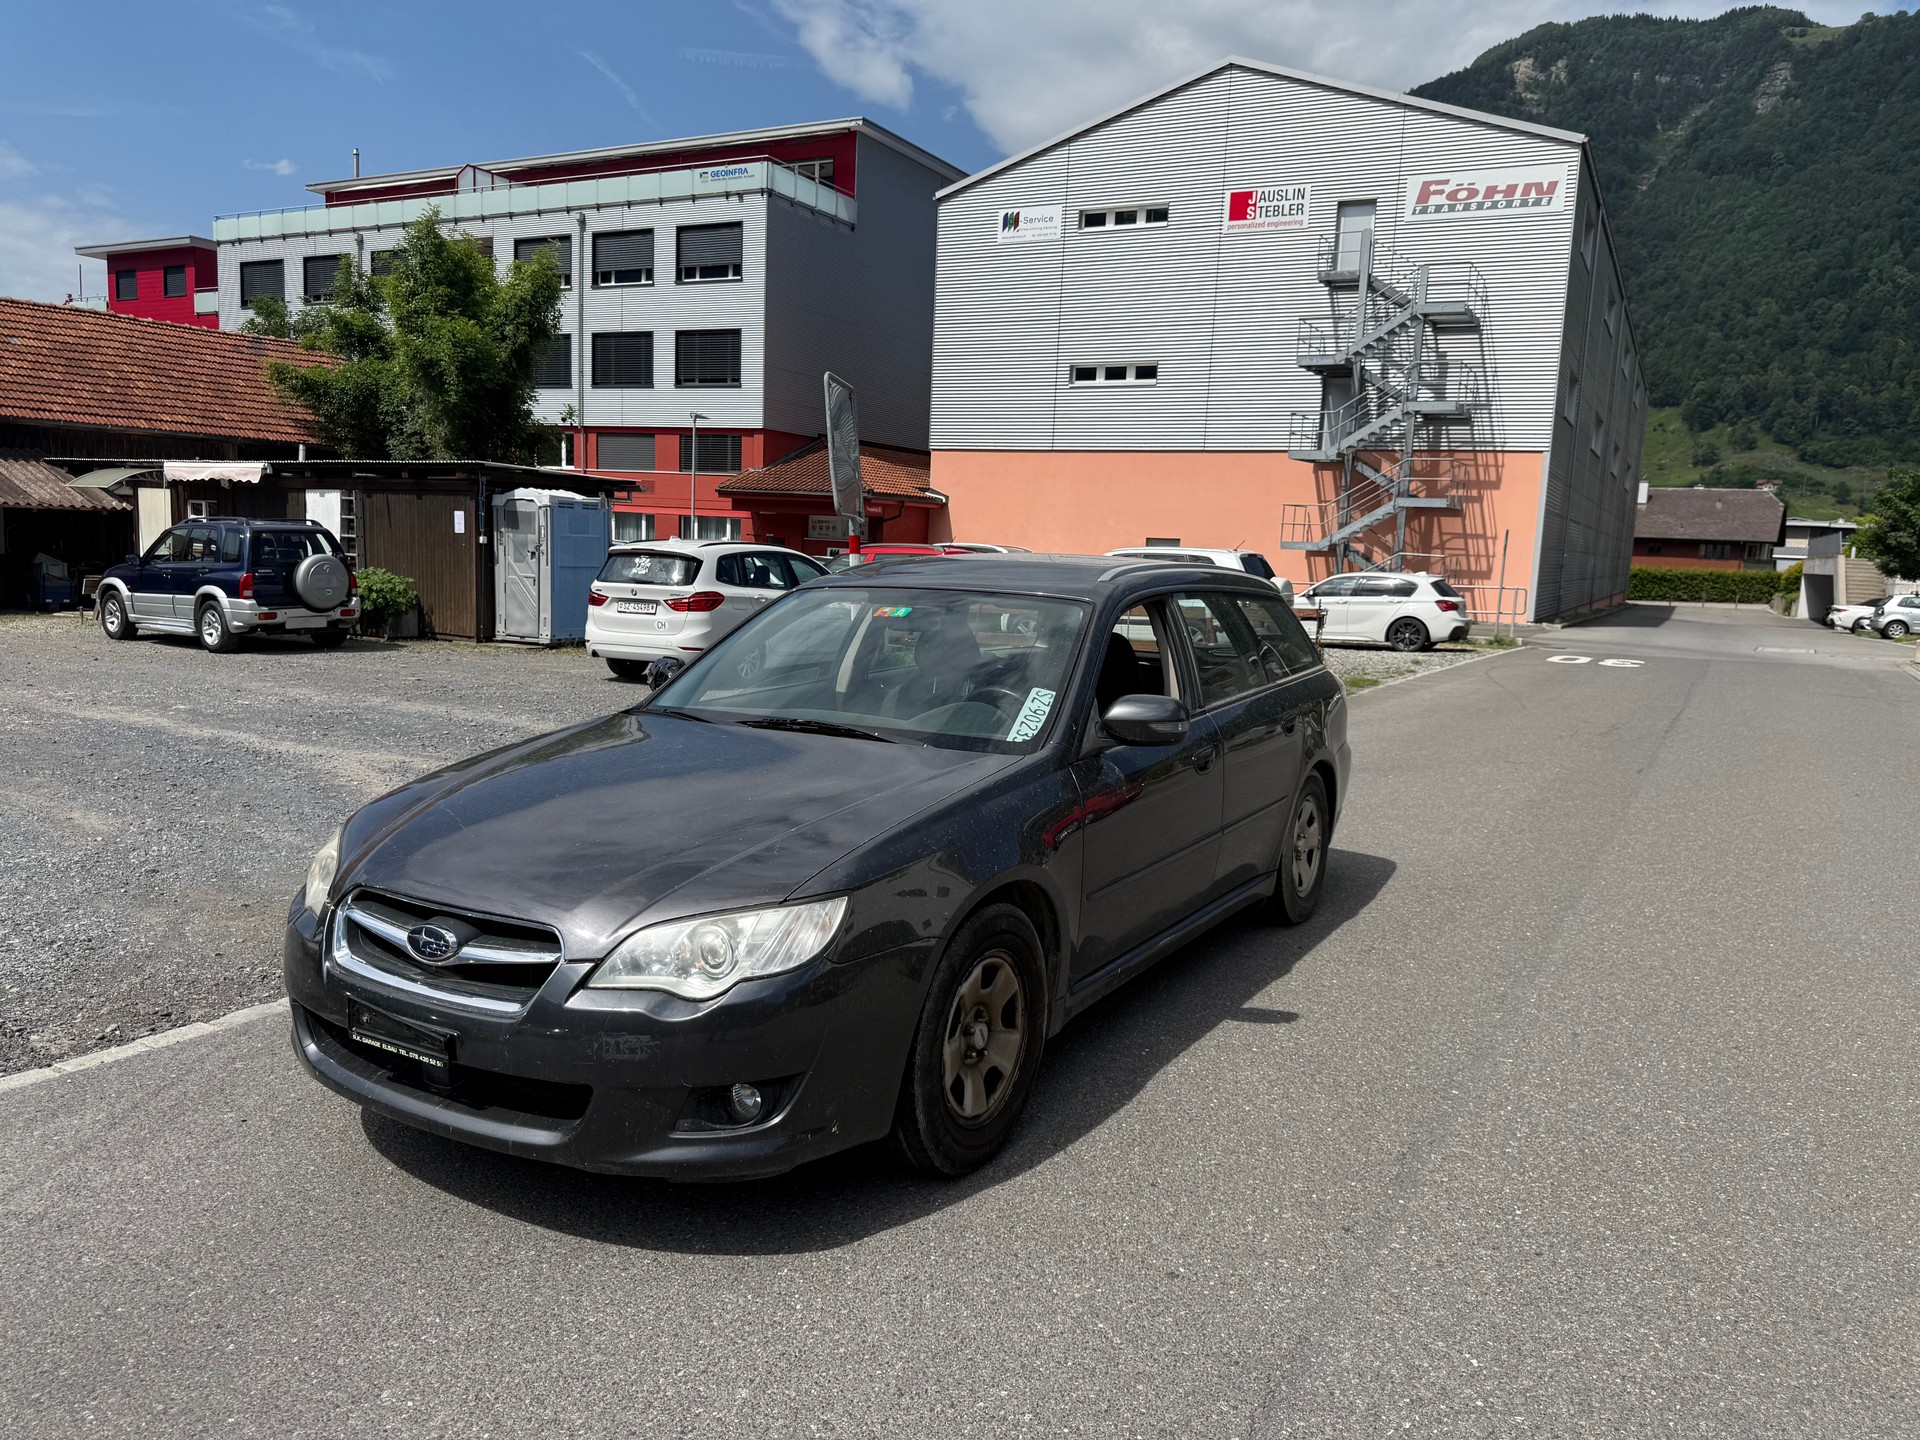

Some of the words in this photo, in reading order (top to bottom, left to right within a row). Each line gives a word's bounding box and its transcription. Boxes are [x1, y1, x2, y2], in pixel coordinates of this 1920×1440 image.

[710, 167, 749, 178] GEOINFRA
[1248, 187, 1306, 205] JAUSLIN
[1414, 178, 1559, 206] FÖHN
[1246, 202, 1305, 220] STEBLER
[1414, 197, 1551, 215] TRANSPORTE
[1227, 221, 1266, 232] personalized
[1266, 218, 1304, 229] engineering
[656, 620, 667, 630] CH
[361, 1037, 381, 1048] GARAGE
